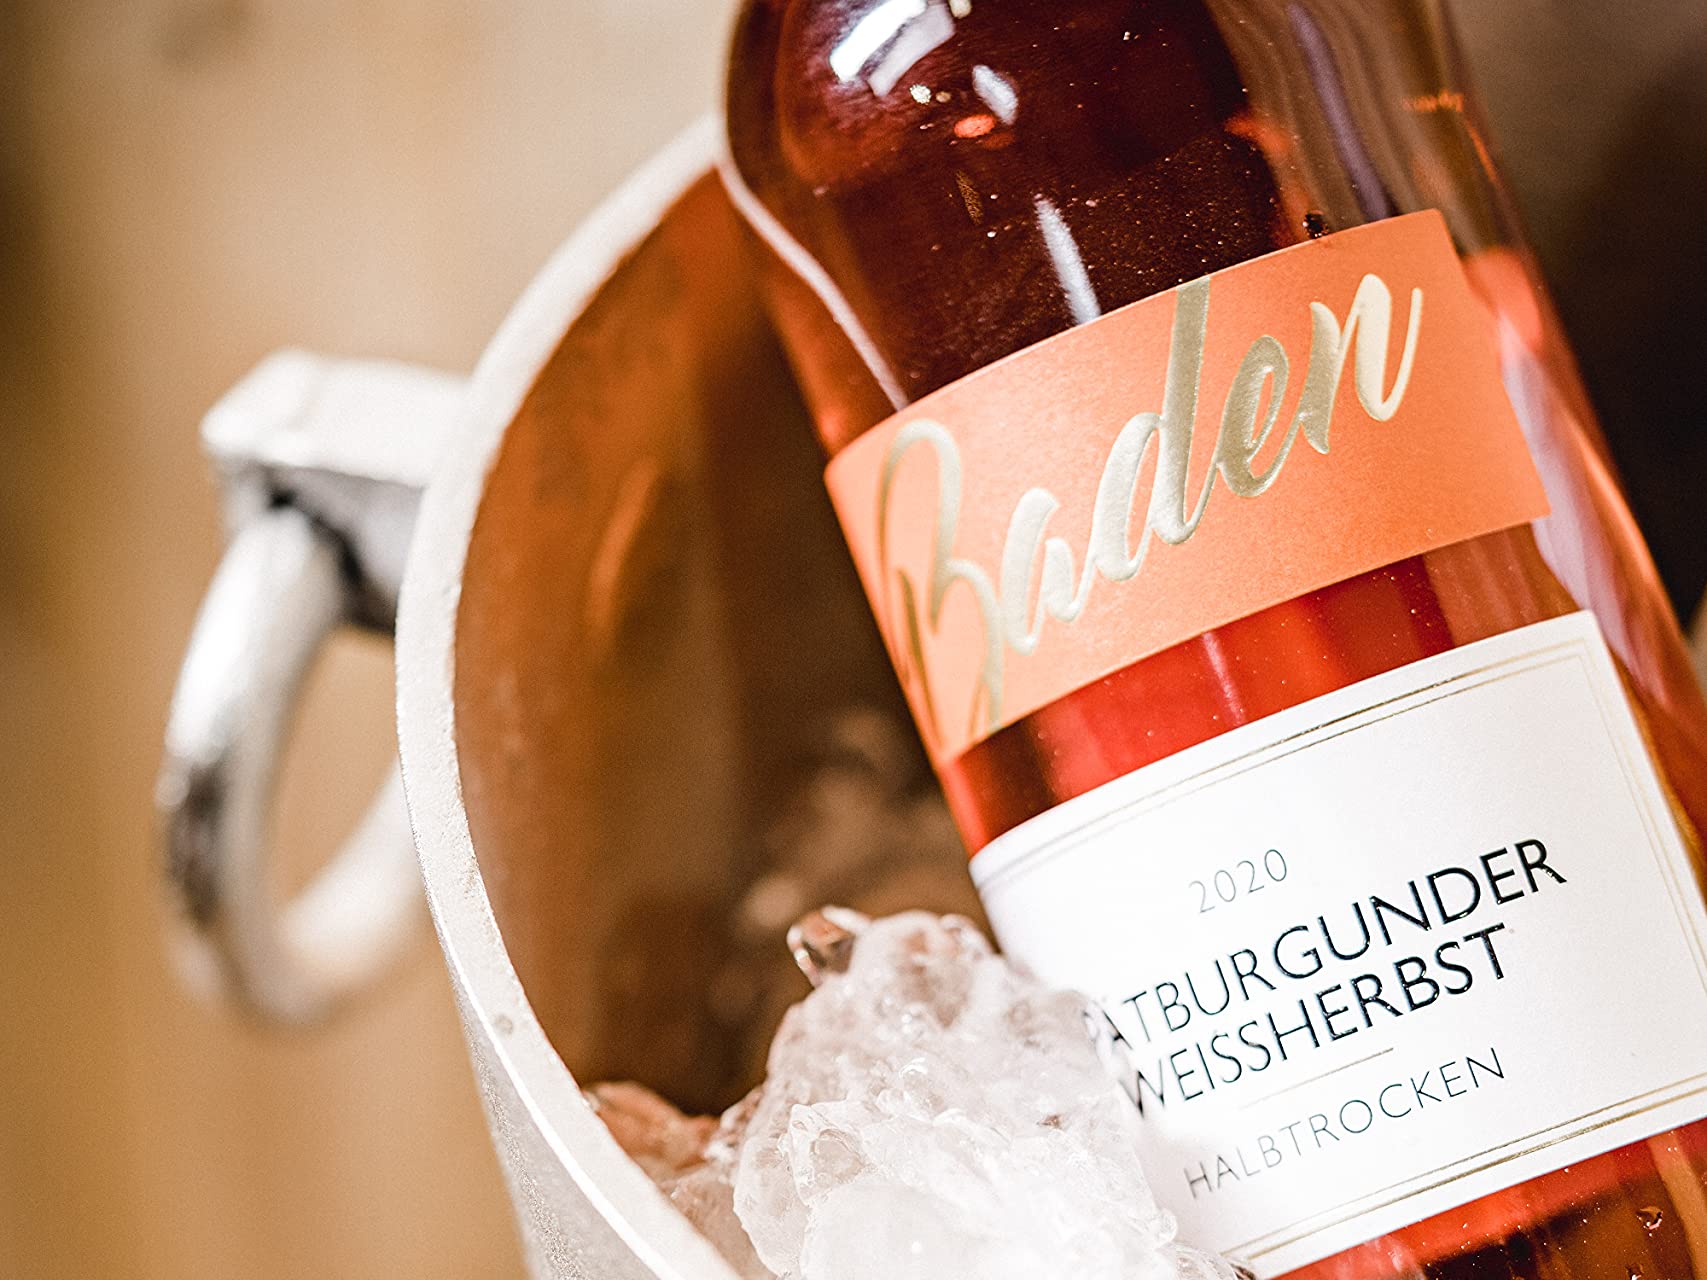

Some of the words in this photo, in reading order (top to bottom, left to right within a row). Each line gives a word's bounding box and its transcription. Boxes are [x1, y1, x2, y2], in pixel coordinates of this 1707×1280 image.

[879, 273, 1422, 745] Baden
[1188, 849, 1288, 914] 2020
[1117, 922, 1507, 1120] WEISSHERBST
[1183, 1047, 1506, 1200] HALBTROCKEN
